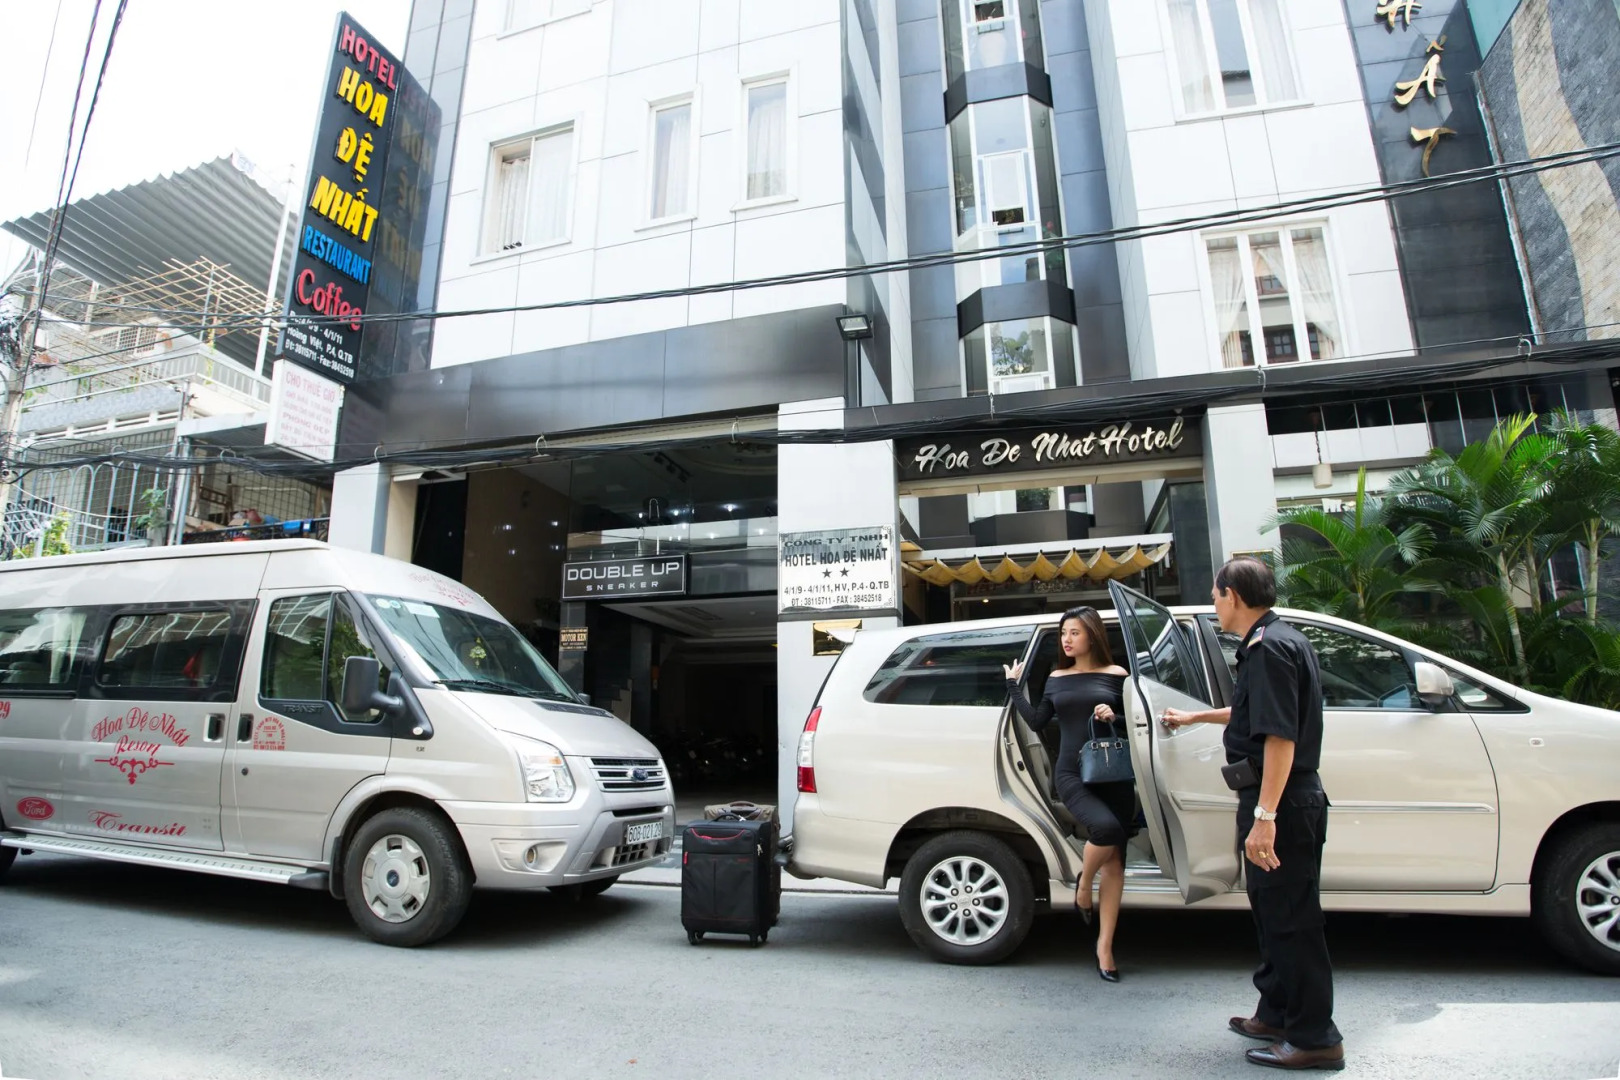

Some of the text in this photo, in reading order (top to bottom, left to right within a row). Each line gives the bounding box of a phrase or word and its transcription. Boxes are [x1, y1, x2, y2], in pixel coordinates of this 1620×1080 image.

[341, 24, 397, 91] HOTEL
[337, 66, 389, 128] HOA
[336, 126, 374, 183] ĐỆ
[311, 175, 379, 243] NHẤT
[303, 225, 371, 285] RESTAURANT
[297, 268, 363, 331] Coffee
[915, 416, 1184, 473] Hoa De Nhat Hotel
[826, 537, 844, 545] TY
[851, 534, 888, 542] TNHH
[785, 542, 888, 567] HOTEL HOA ĐỆ NHẤT
[567, 562, 680, 581] DOUBLE UP
[586, 581, 659, 592] SNEAKER
[784, 585, 803, 596] 4/1/9
[869, 580, 889, 590] Q.TB
[836, 595, 849, 604] FAX
[90, 716, 122, 743] Hoa
[115, 734, 162, 757] Resort
[24, 800, 46, 816] Ford
[88, 809, 187, 837] Transit
